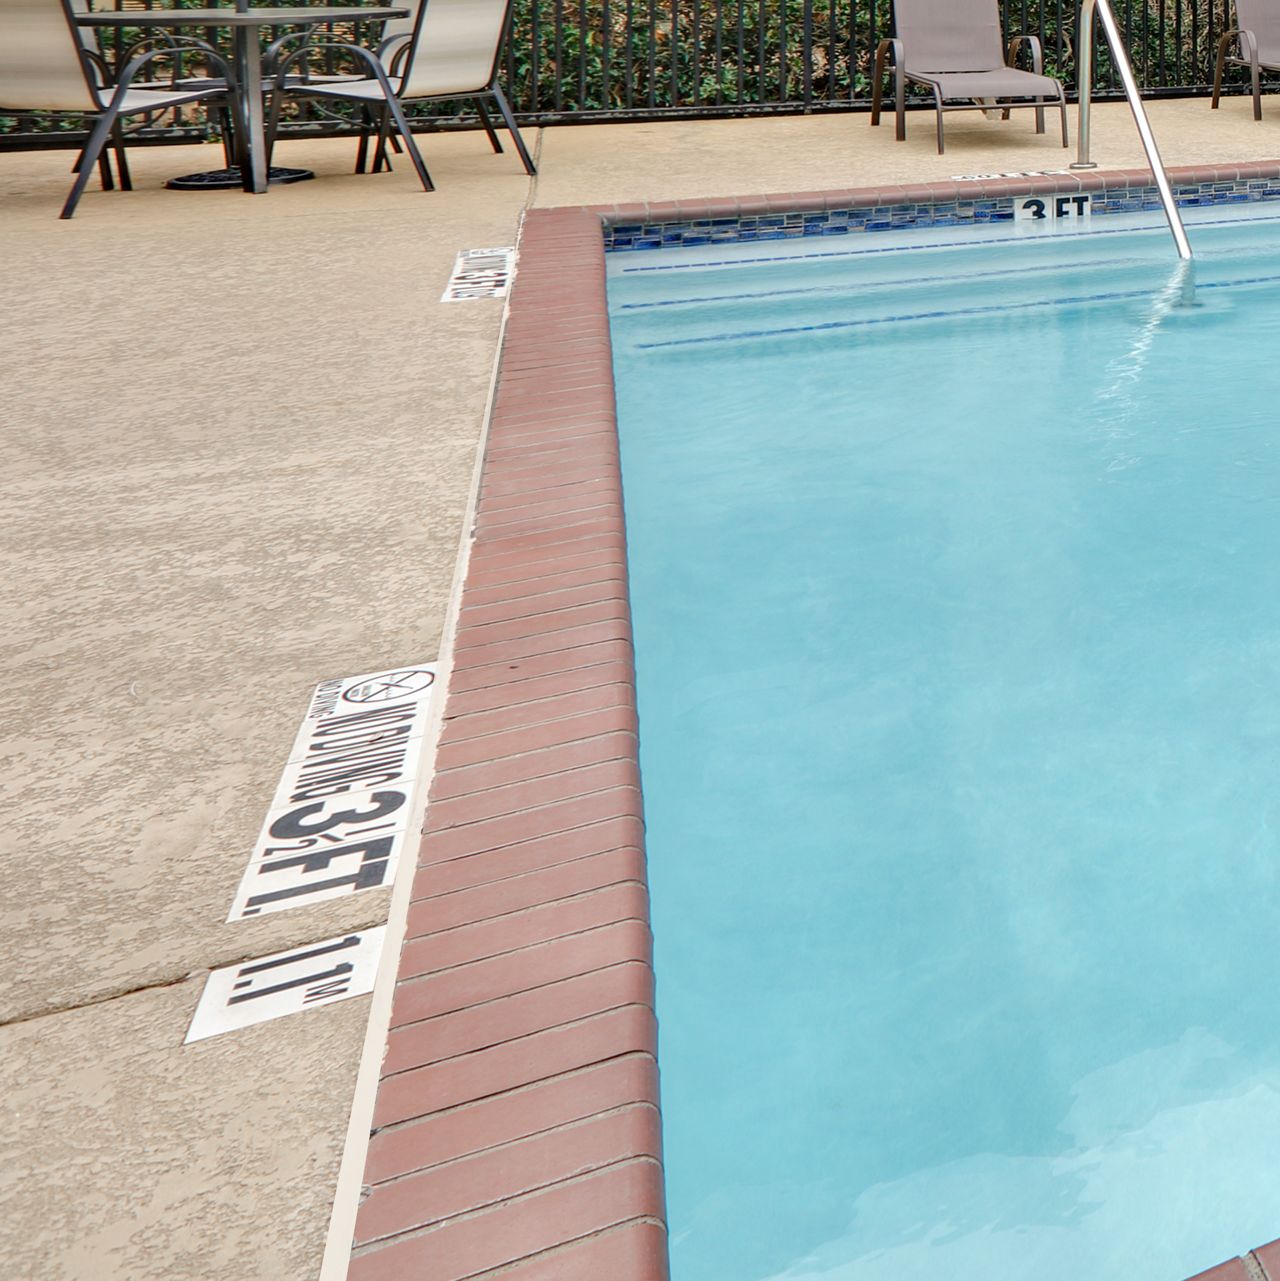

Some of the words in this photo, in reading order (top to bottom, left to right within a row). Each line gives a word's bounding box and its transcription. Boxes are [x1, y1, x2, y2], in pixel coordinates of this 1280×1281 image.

[1056, 195, 1089, 218] FT
[312, 701, 418, 737] NO
[290, 723, 413, 804] DIVING
